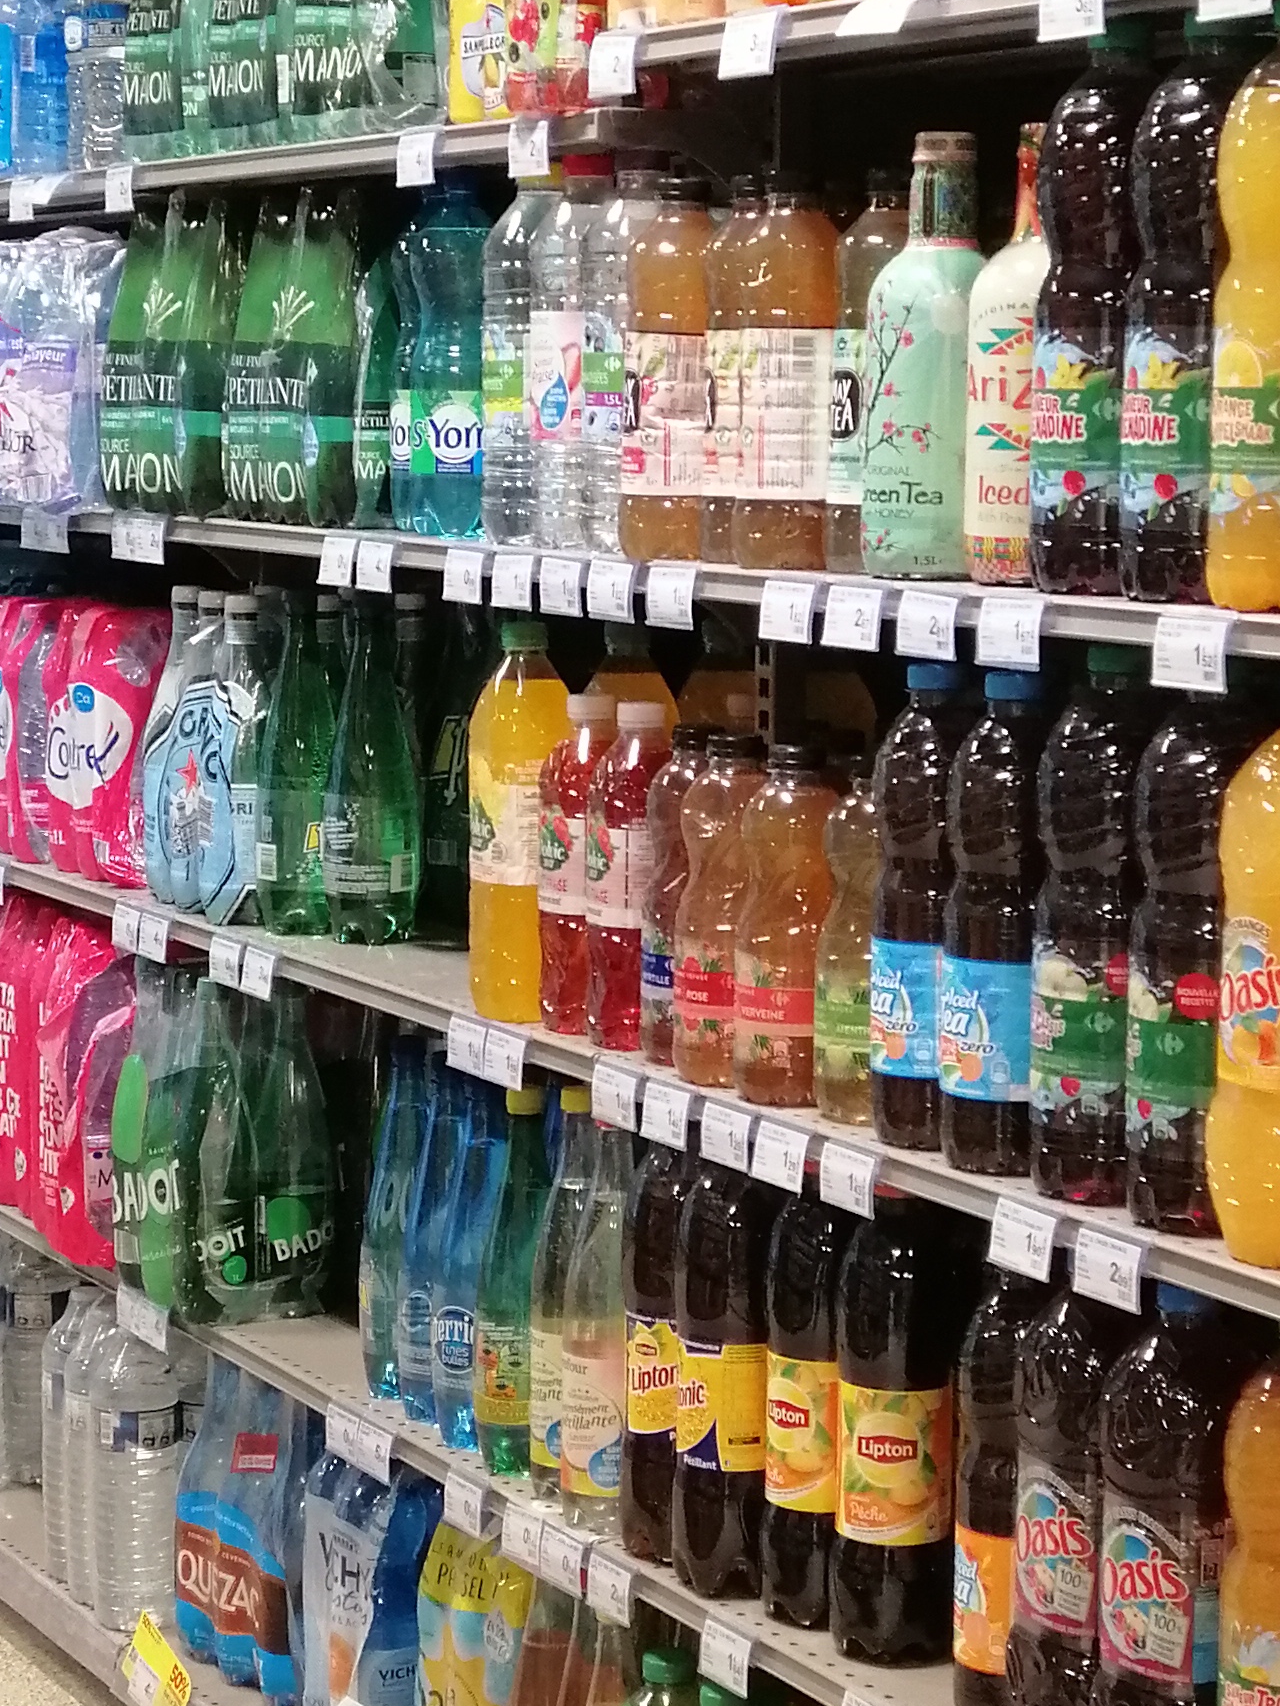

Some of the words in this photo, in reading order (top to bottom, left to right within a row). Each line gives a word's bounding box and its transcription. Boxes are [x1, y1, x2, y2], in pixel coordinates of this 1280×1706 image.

[901, 481, 942, 505] Tea
[769, 1407, 805, 1425] Lipton
[861, 1441, 913, 1458] Lipton
